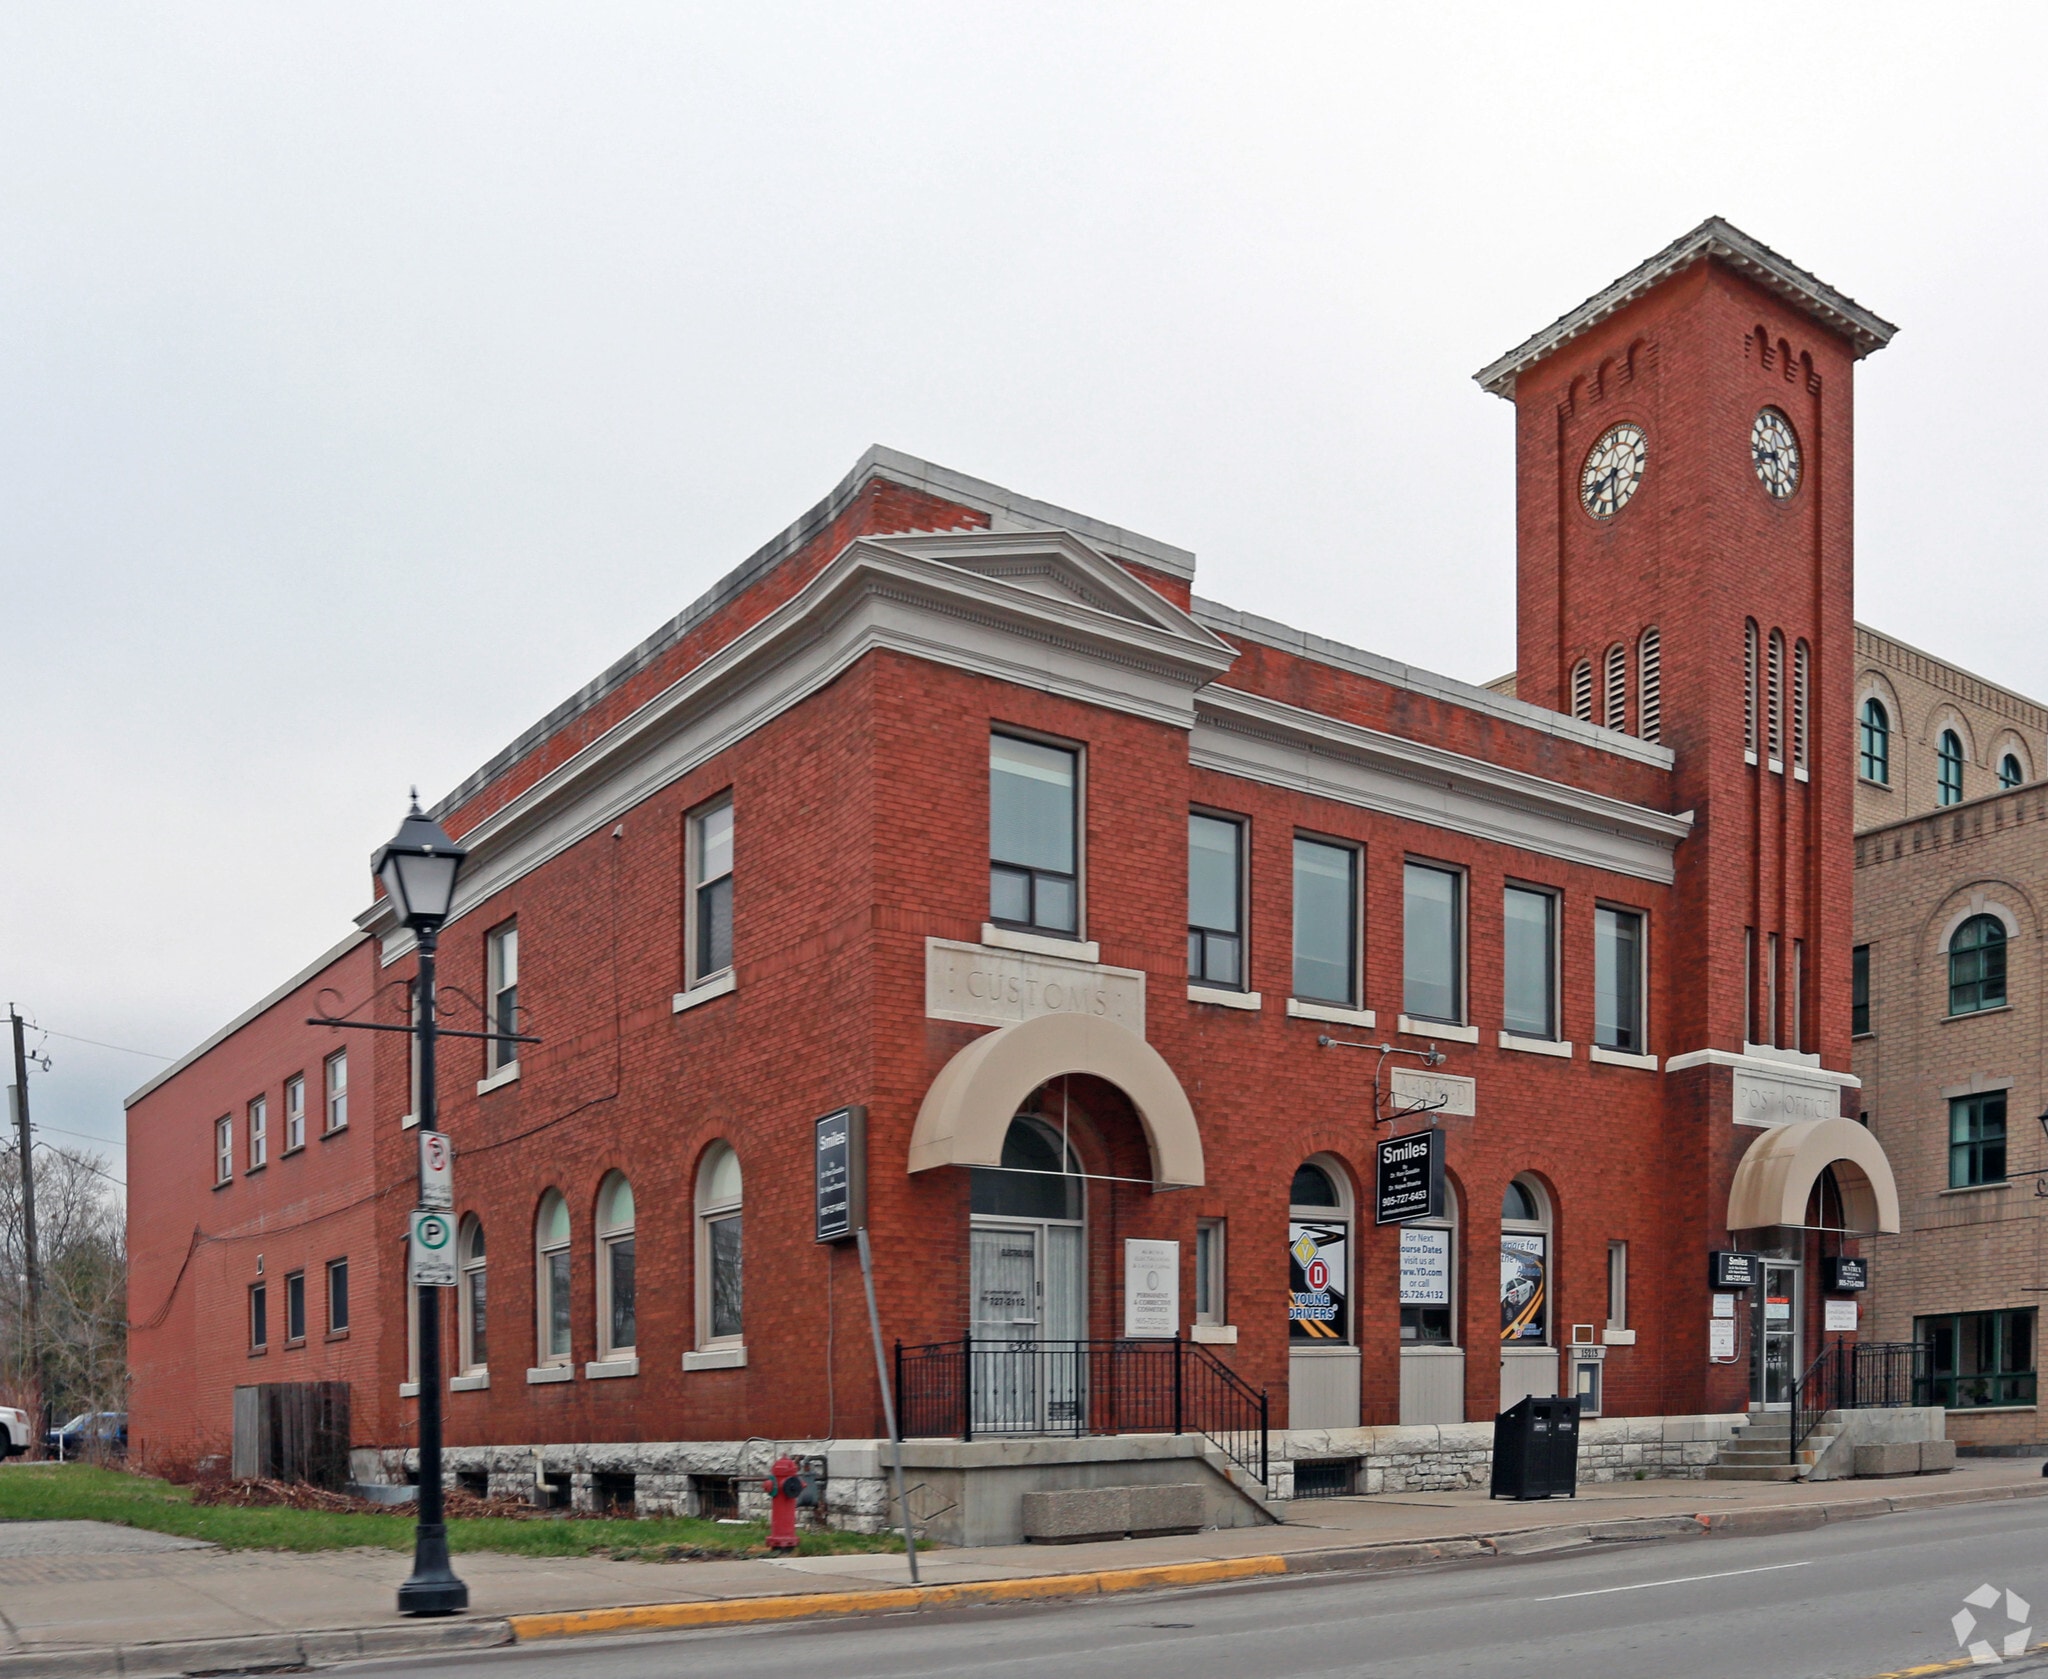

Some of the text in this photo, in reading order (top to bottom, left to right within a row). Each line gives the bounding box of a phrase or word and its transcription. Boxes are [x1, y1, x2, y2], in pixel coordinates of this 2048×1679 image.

[966, 971, 1107, 1016] CUSTOMS
[1740, 1087, 1831, 1119] POST OFFICE
[819, 1130, 846, 1151] Smiles
[1383, 1142, 1428, 1164] Smiles
[1382, 1190, 1427, 1207] 905-727-6453
[425, 1223, 441, 1242] P
[1405, 1233, 1434, 1242] For Next
[1422, 1245, 1443, 1254] Dates
[1526, 1239, 1538, 1251] for
[1404, 1256, 1418, 1264] visit
[1728, 1256, 1749, 1266] Smiles
[1313, 1266, 1323, 1284] D
[1418, 1279, 1429, 1287] call
[1294, 1293, 1330, 1305] YOUNG
